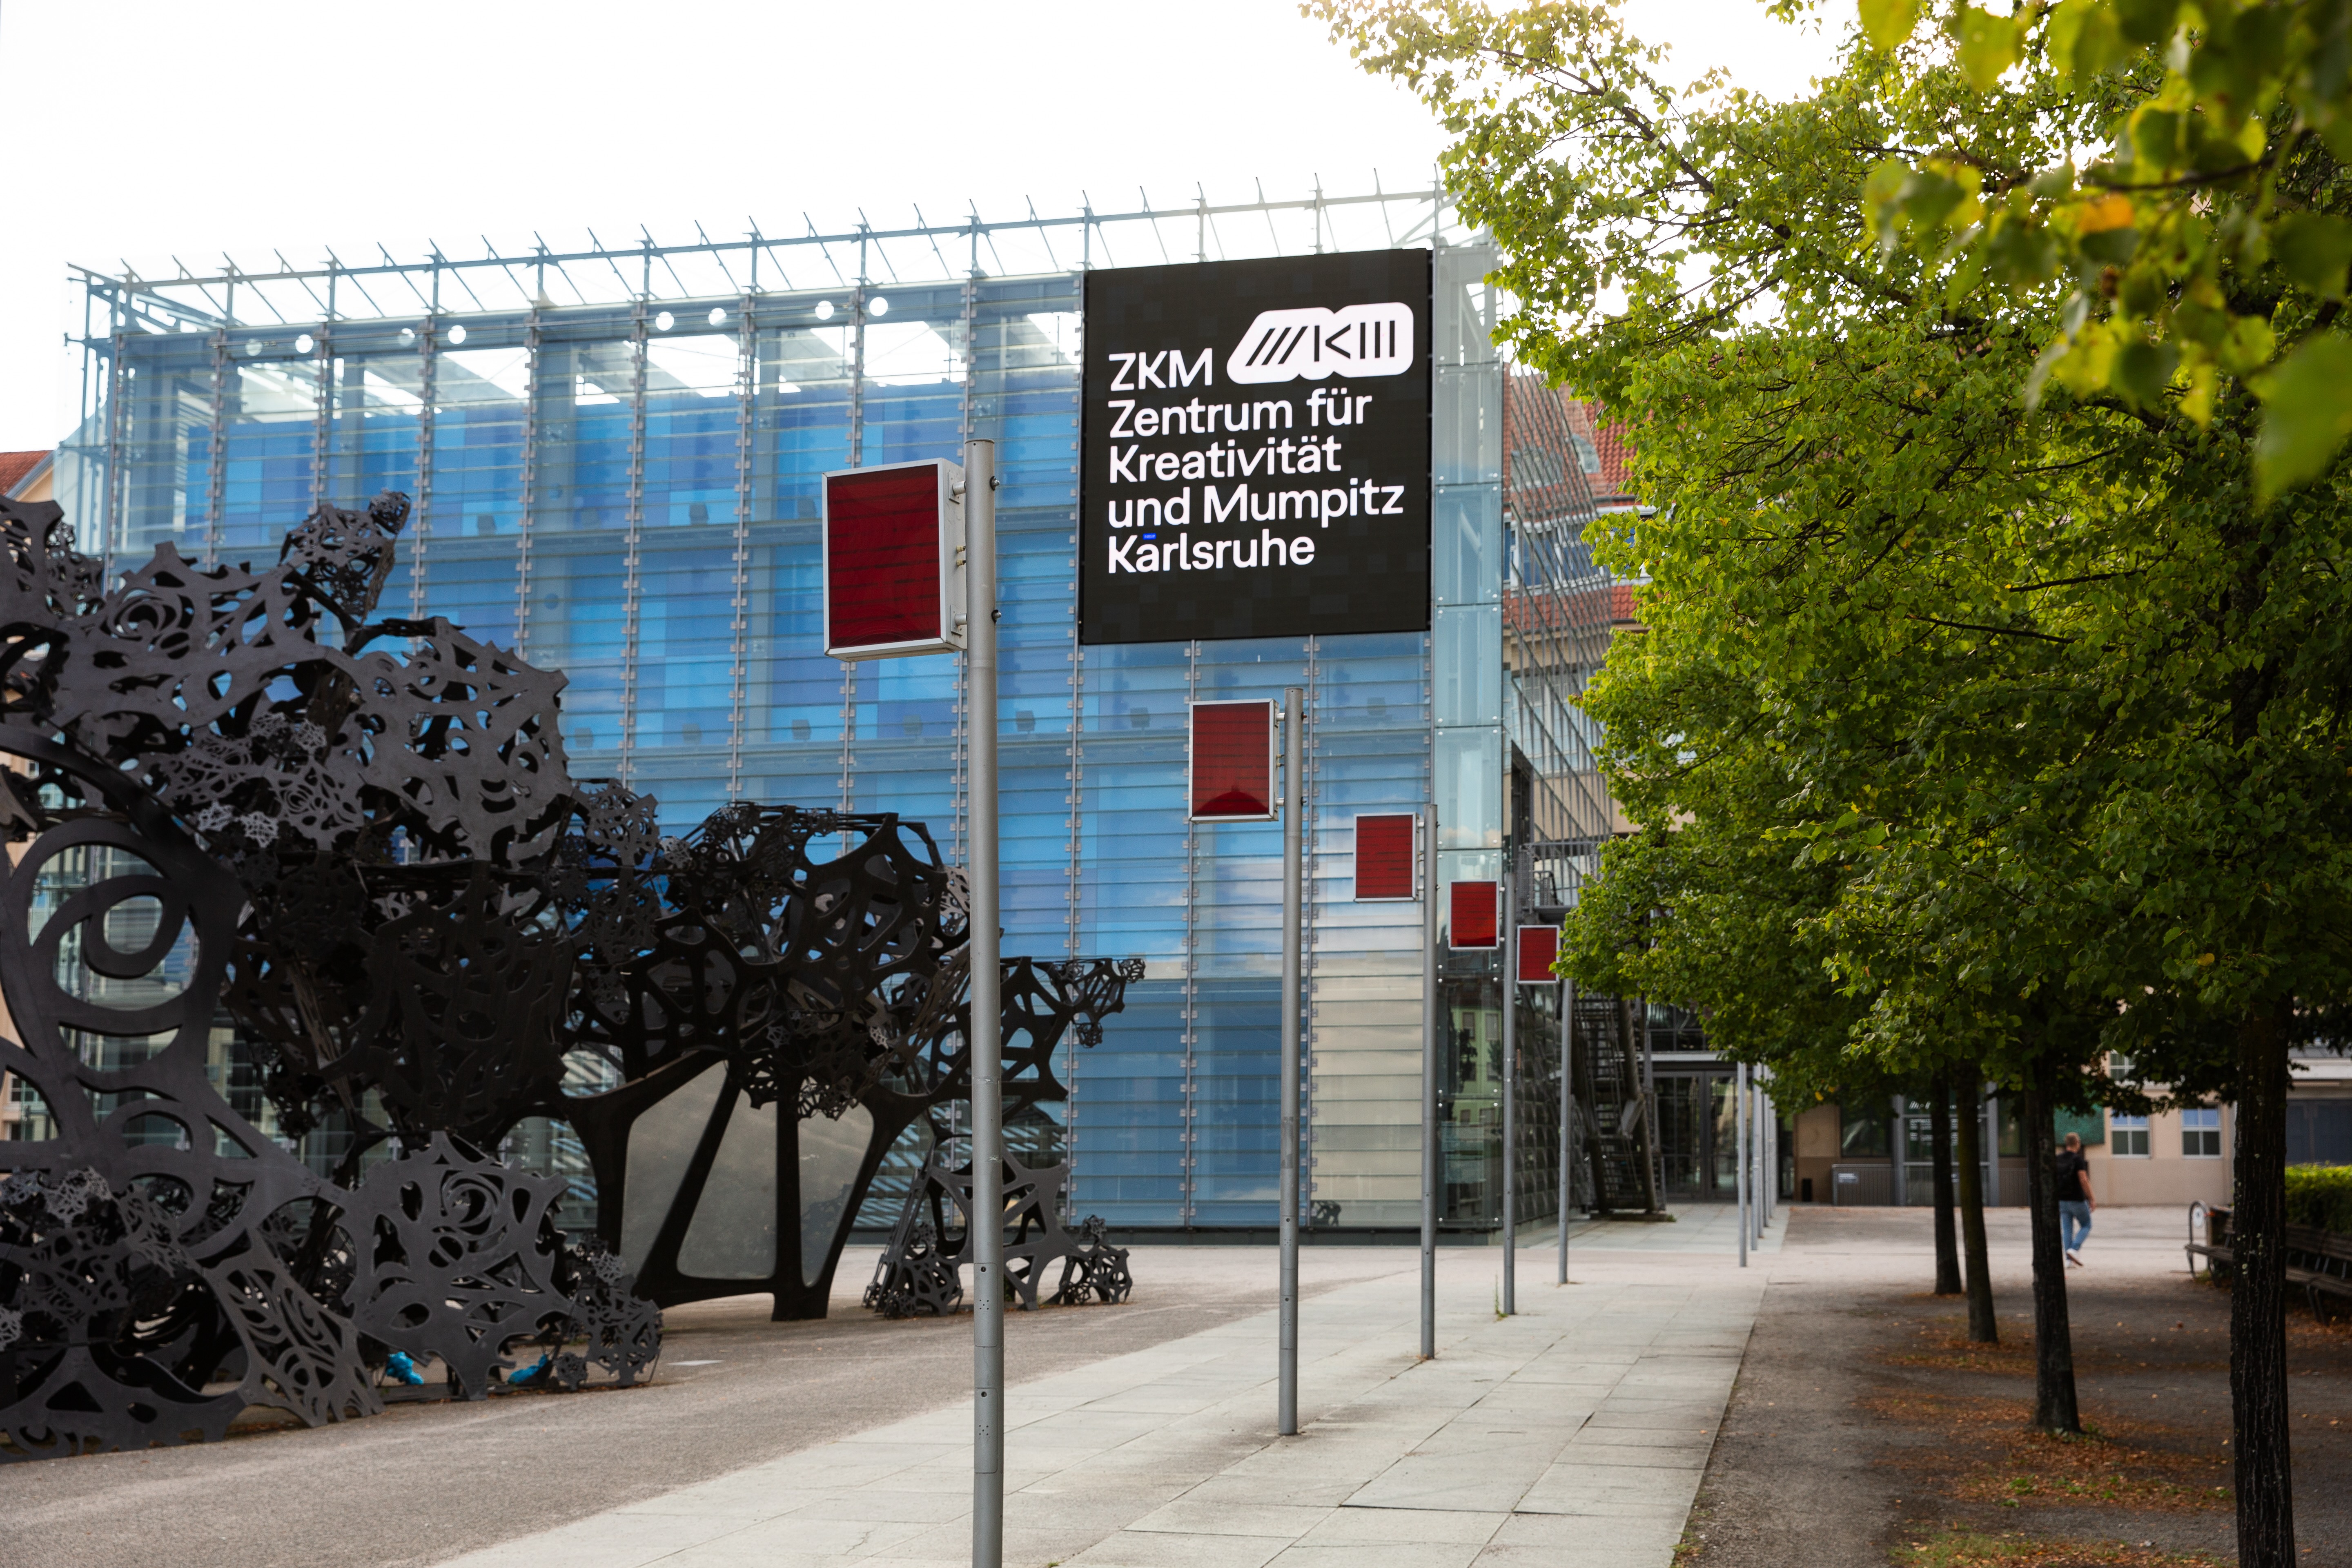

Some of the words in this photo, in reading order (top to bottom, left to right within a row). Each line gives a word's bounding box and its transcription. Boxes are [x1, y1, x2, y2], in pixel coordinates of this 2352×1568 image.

[1108, 347, 1213, 392] ZKM
[1108, 397, 1293, 438] Zentrum
[1306, 388, 1373, 427] für
[1109, 435, 1342, 484] Kreativität
[1108, 486, 1191, 529] und
[1203, 477, 1405, 528] Mumpitz
